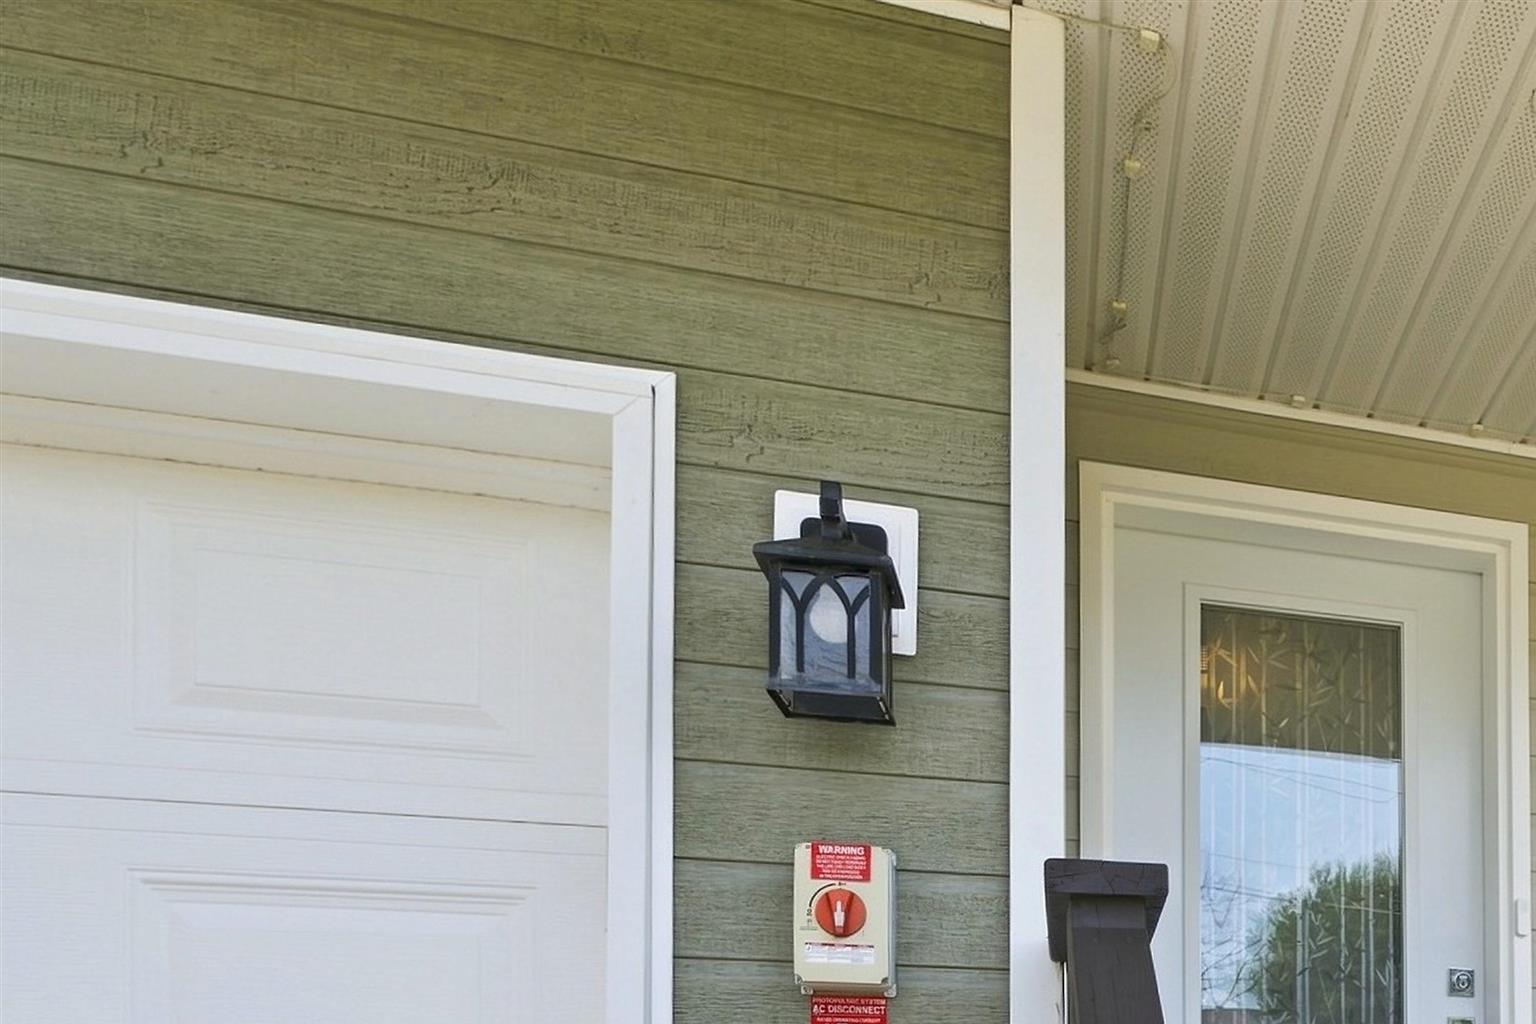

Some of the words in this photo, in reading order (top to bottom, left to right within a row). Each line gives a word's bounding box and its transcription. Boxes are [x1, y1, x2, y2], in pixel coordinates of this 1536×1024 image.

[818, 845, 865, 855] WARNING
[813, 1004, 825, 1013] AC
[828, 1005, 886, 1014] DISCONNECT
